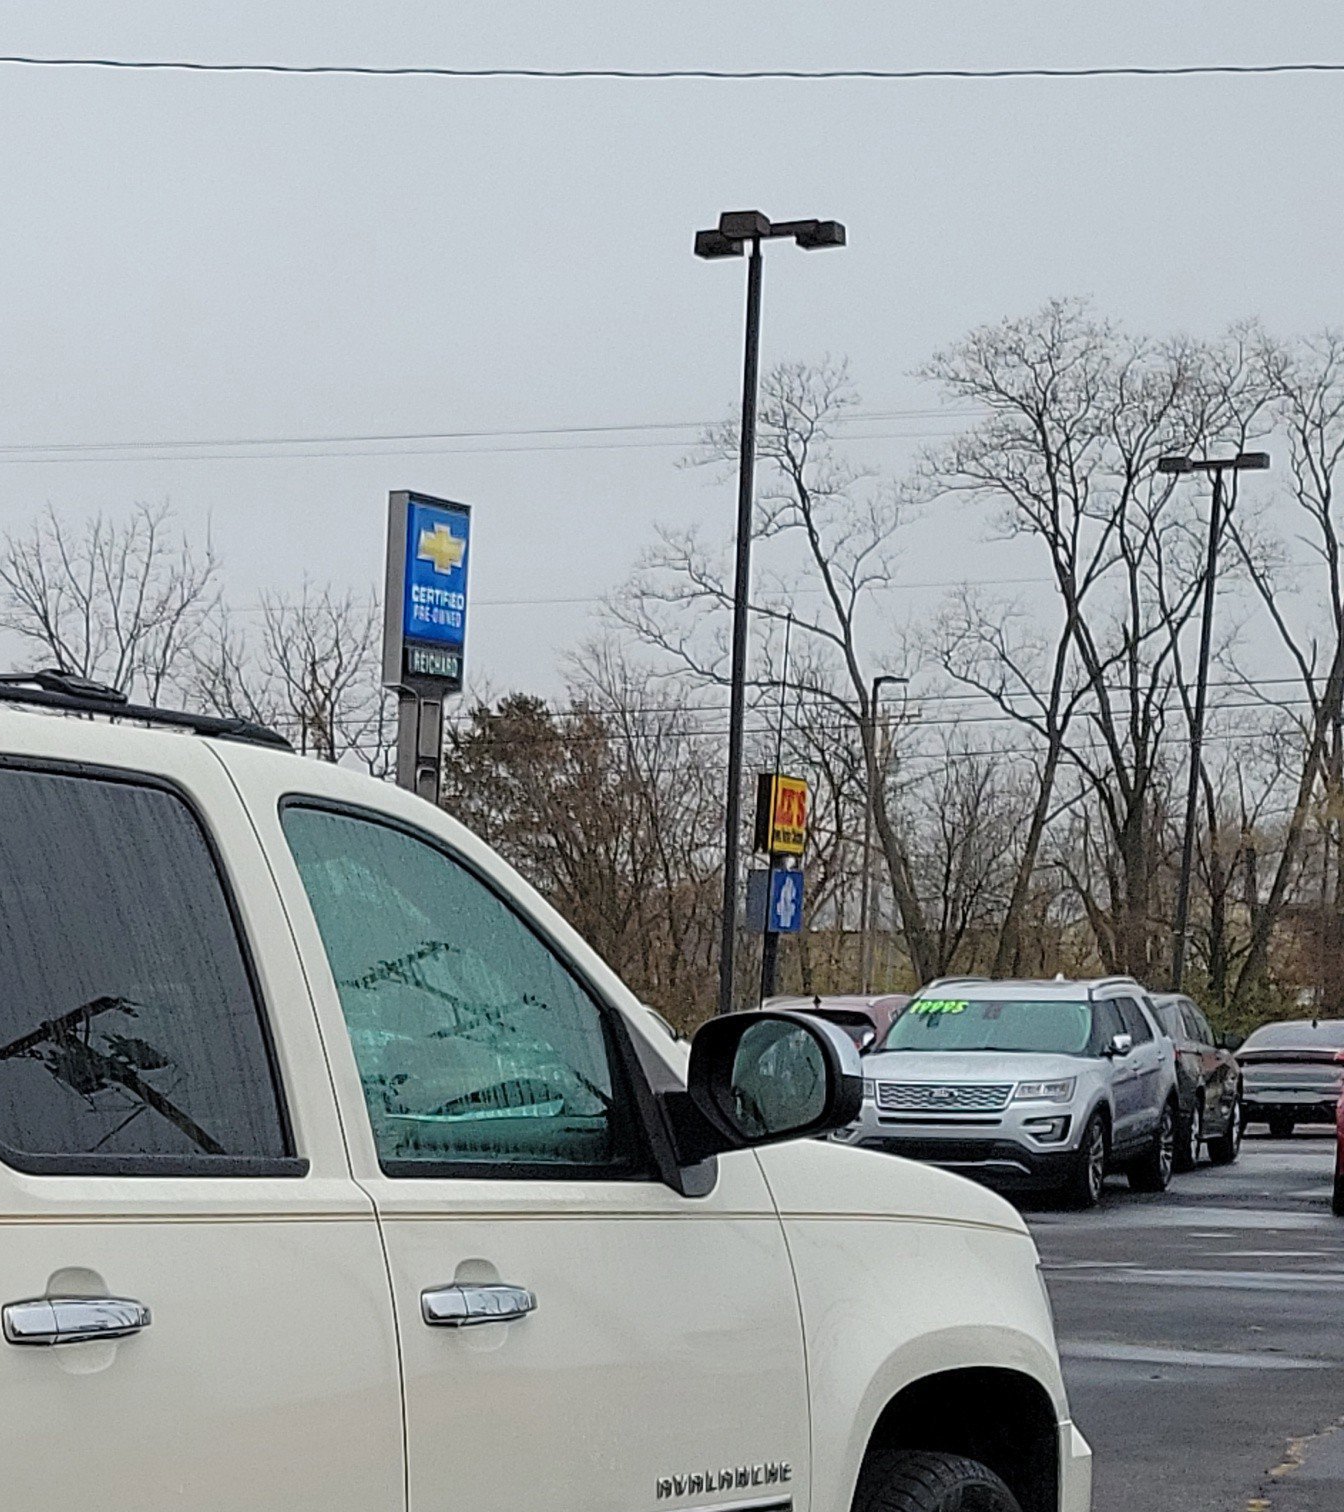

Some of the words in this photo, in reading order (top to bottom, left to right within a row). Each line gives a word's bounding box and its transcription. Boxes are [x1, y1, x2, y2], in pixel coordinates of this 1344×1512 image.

[411, 583, 465, 611] CERTIFIED
[413, 605, 462, 628] PRE-OWNED
[414, 650, 458, 677] REICHARD
[656, 1460, 792, 1500] AVALANCHE
